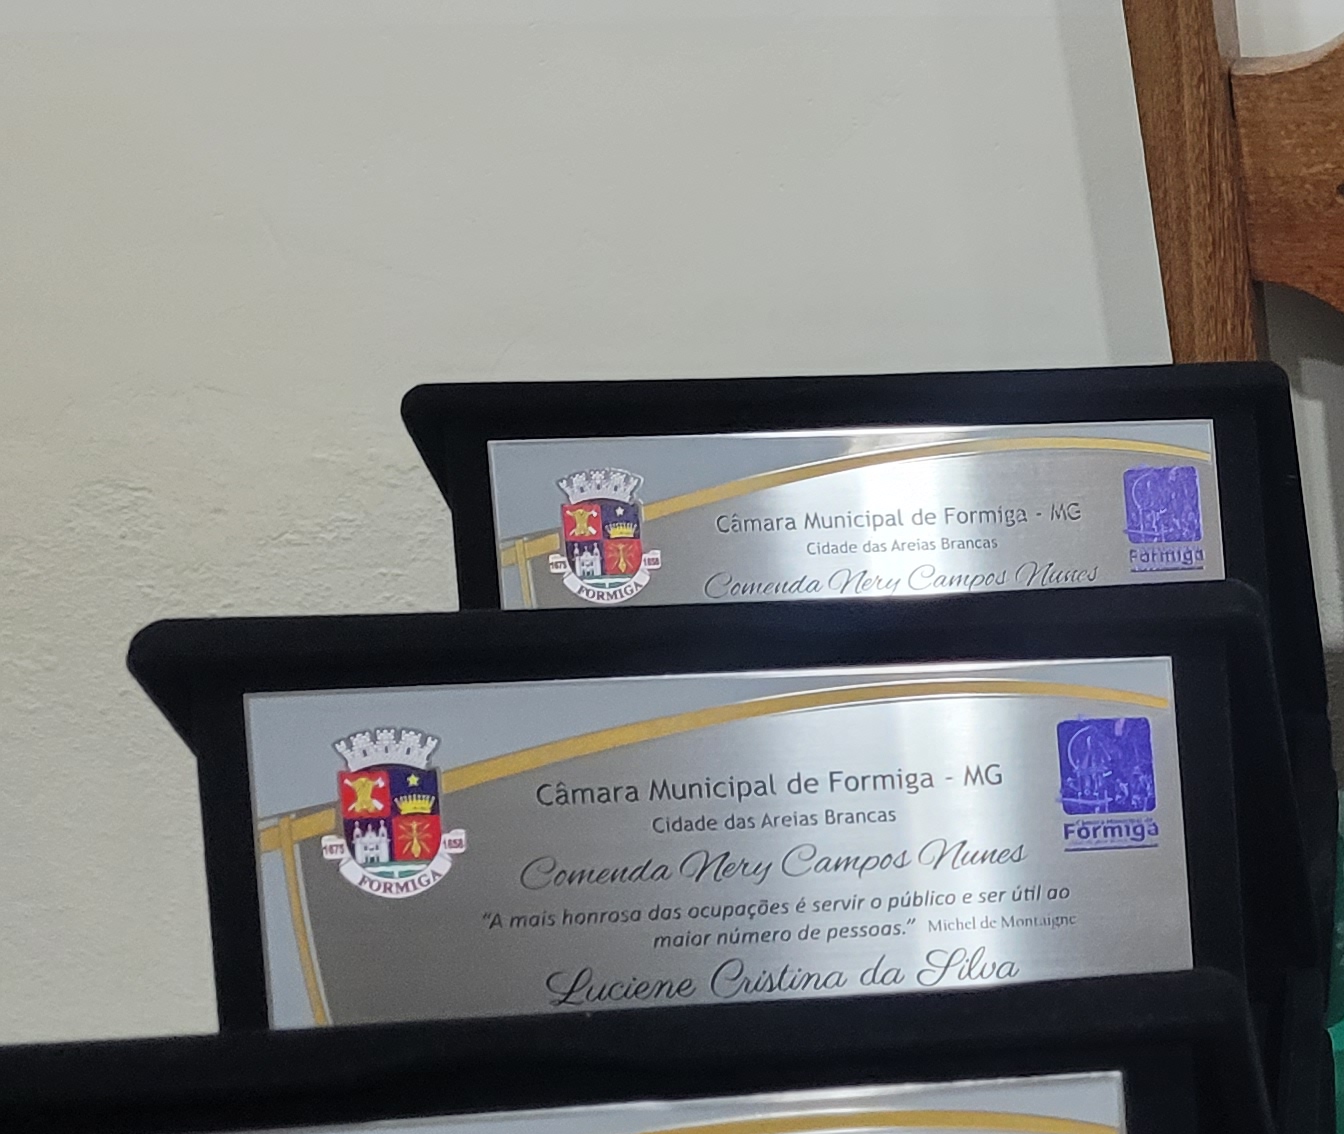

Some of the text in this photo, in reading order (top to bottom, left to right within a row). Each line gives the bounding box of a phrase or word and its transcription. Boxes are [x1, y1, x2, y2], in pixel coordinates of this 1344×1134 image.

[716, 512, 797, 534] Câmara
[803, 508, 904, 532] Municipal
[911, 508, 937, 526] de
[943, 505, 1028, 528] Formiga
[1050, 501, 1082, 522] MG
[806, 536, 999, 556] Cidade das Areias Brancas
[577, 581, 643, 601] FORMIGA
[703, 570, 824, 600] Comenda
[906, 562, 1008, 593] Campos
[1013, 559, 1101, 589] Nunes
[545, 945, 1020, 1007] Luciene Cristina da Silva
